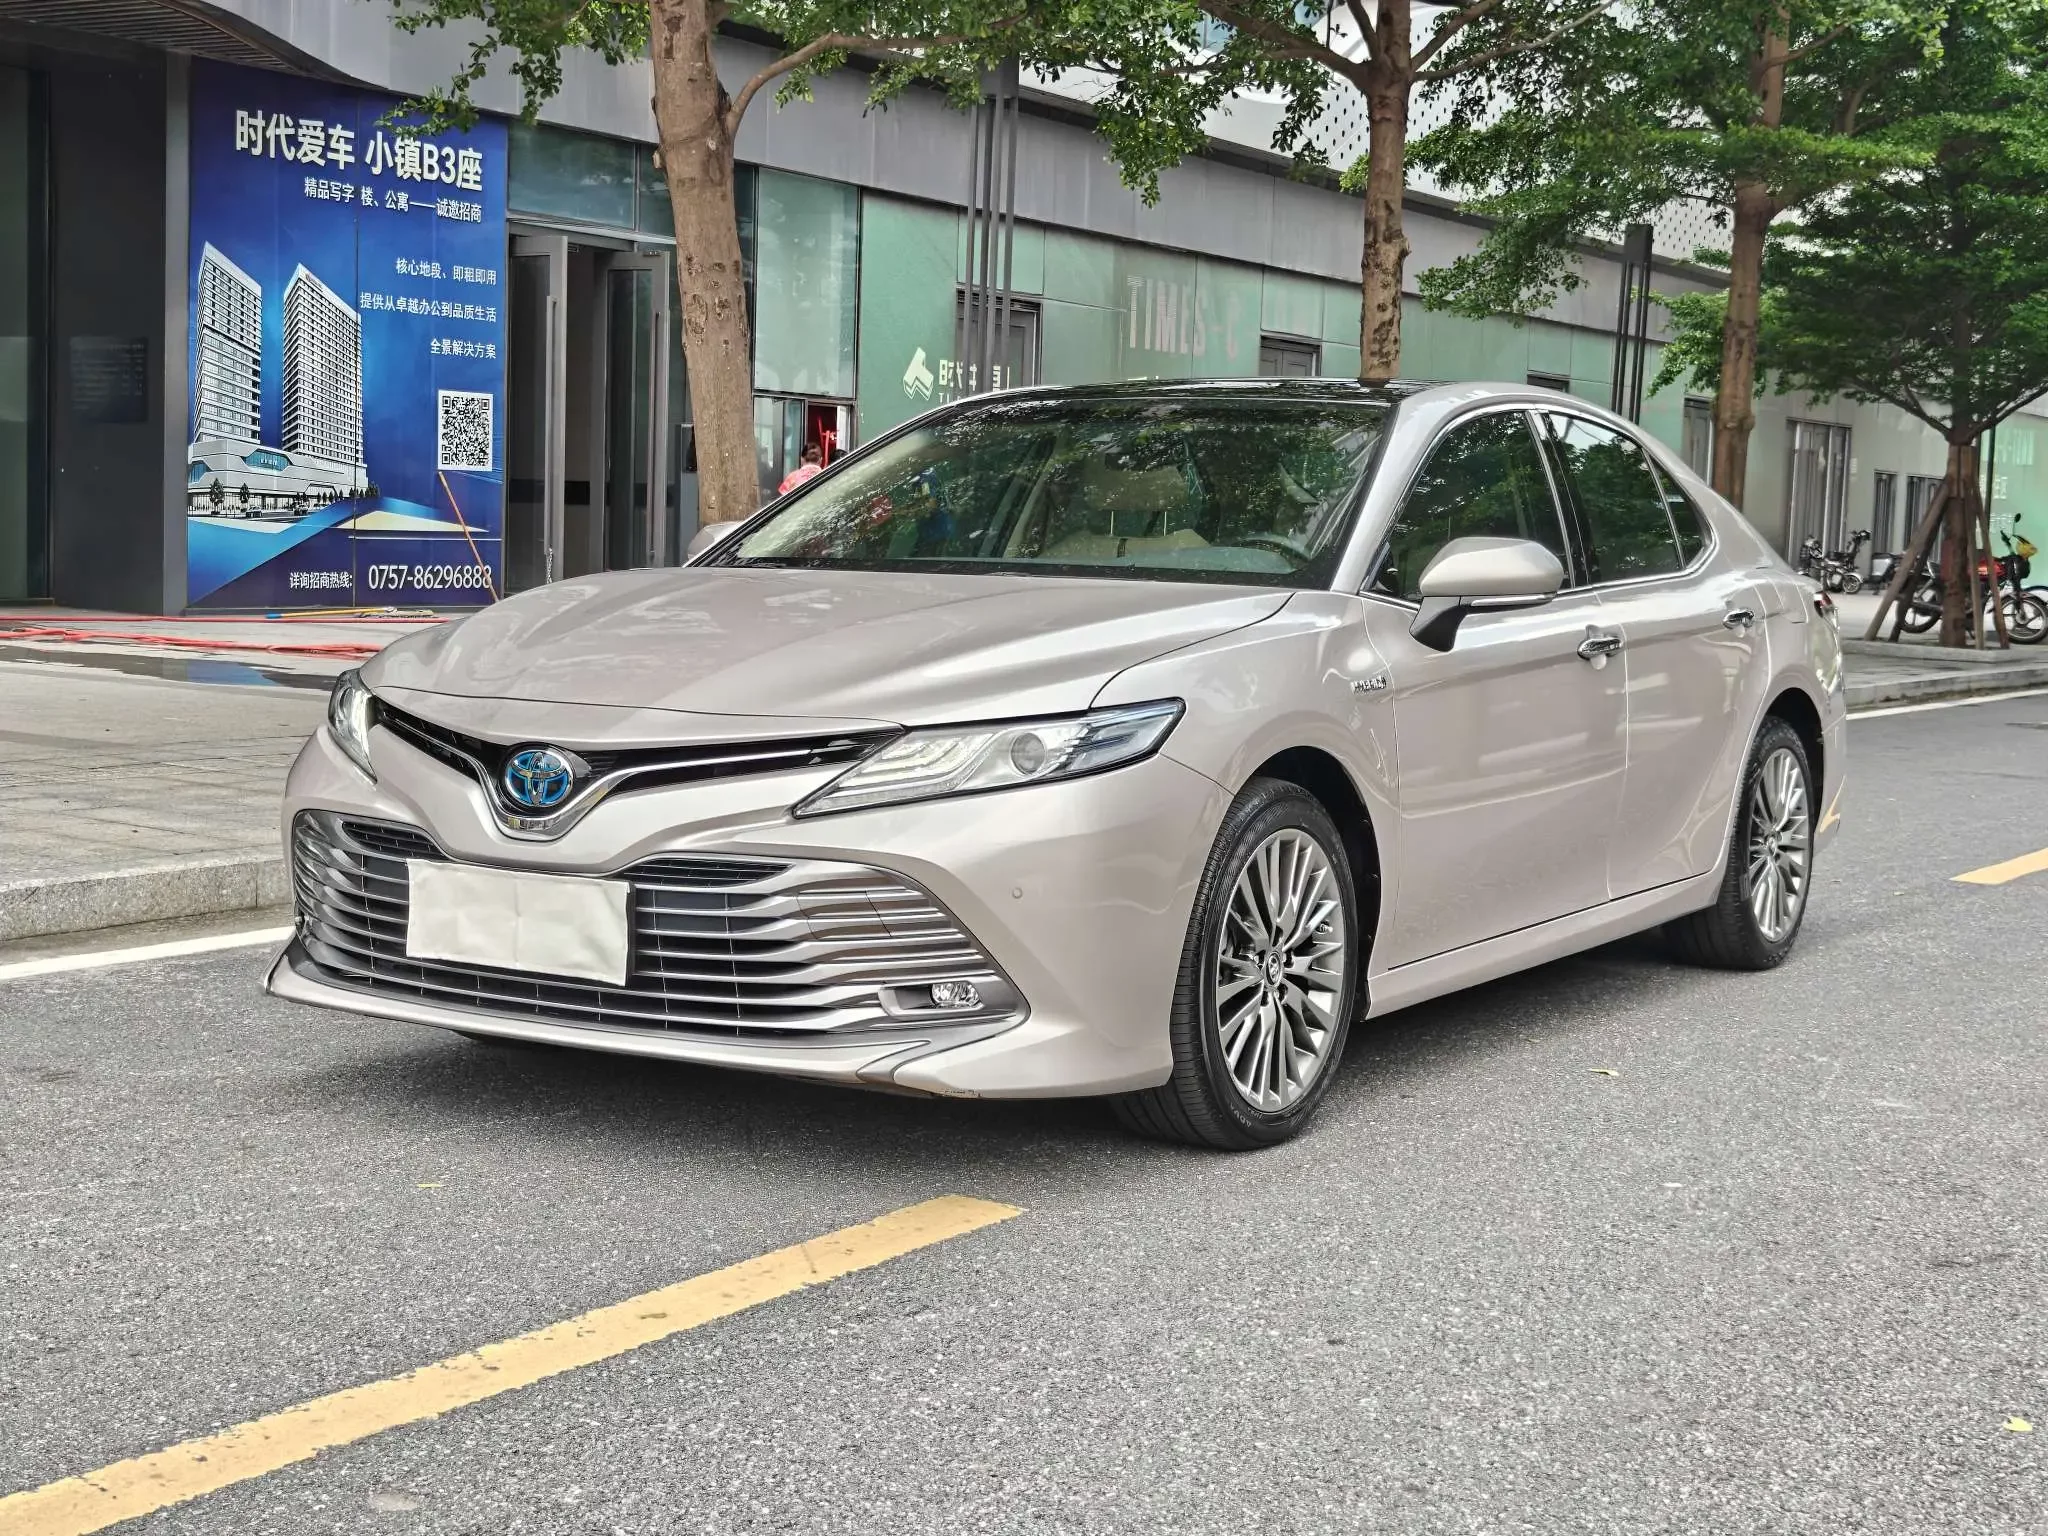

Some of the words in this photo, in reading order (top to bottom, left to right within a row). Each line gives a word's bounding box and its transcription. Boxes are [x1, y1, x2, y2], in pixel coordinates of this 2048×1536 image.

[395, 257, 497, 286] 核心地段、即租即用
[359, 291, 497, 323] 提供从卓越办公到品质生活
[430, 338, 497, 359] 全景解决方案
[368, 565, 492, 590] 0757-86296888
